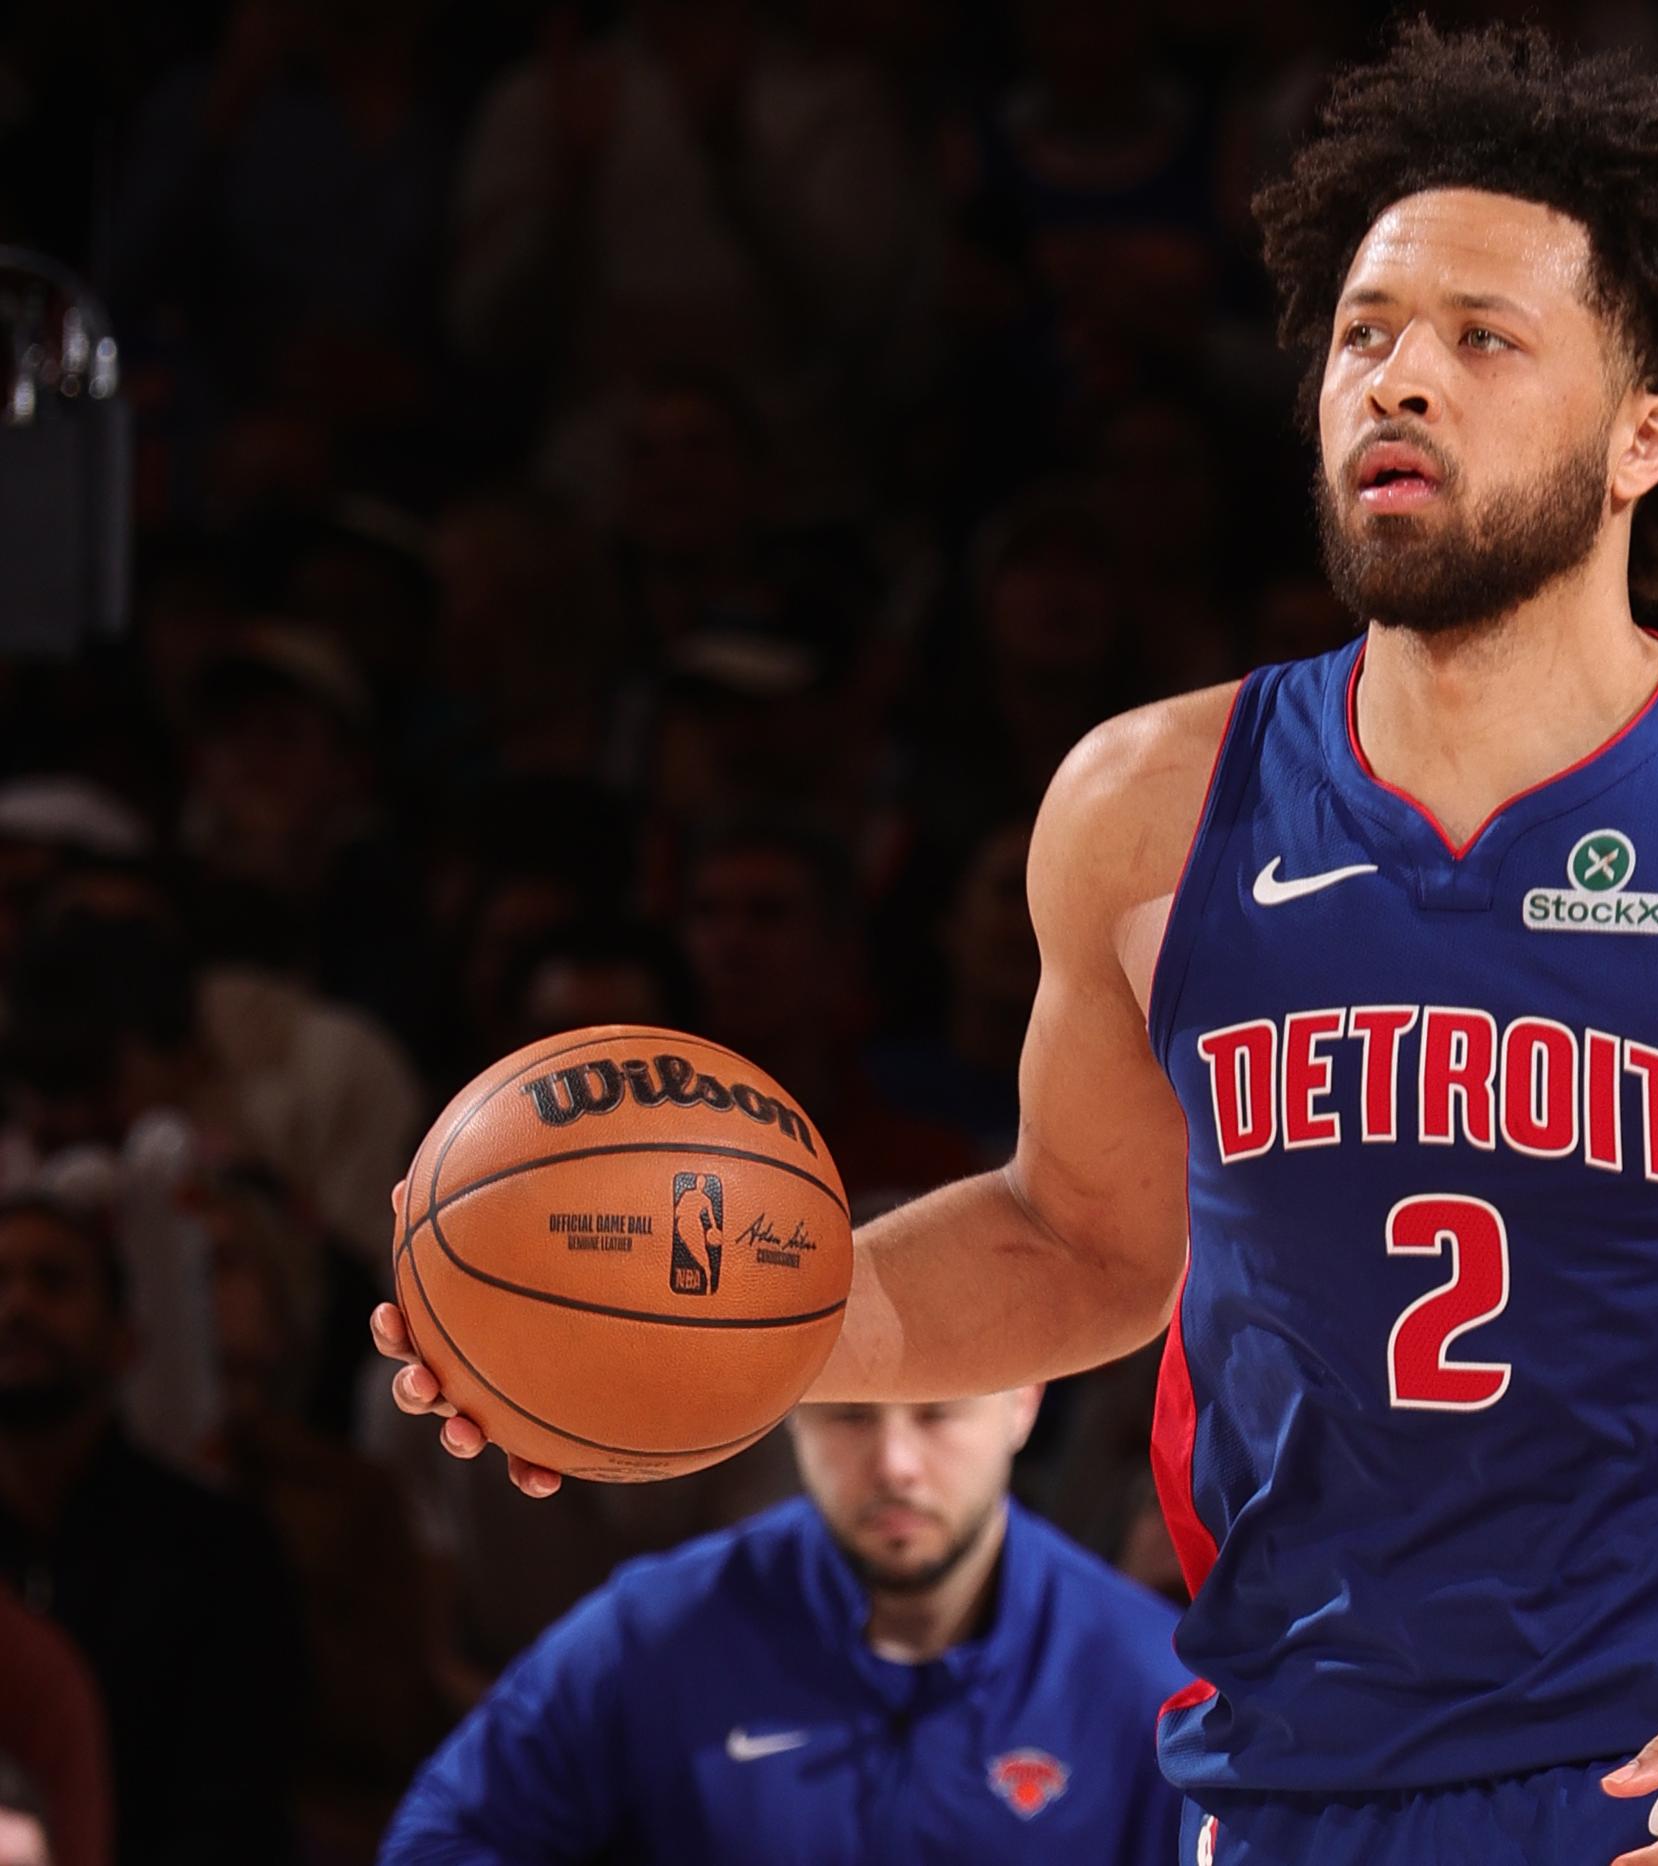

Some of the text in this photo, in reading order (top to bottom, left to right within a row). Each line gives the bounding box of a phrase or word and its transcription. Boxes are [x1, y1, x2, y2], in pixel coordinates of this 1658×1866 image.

[521, 1054, 818, 1160] Wilson
[549, 1213, 653, 1235] OFFICIAL GAME BALL
[675, 1268, 701, 1289] NBA
[1385, 1193, 1511, 1412] 2
